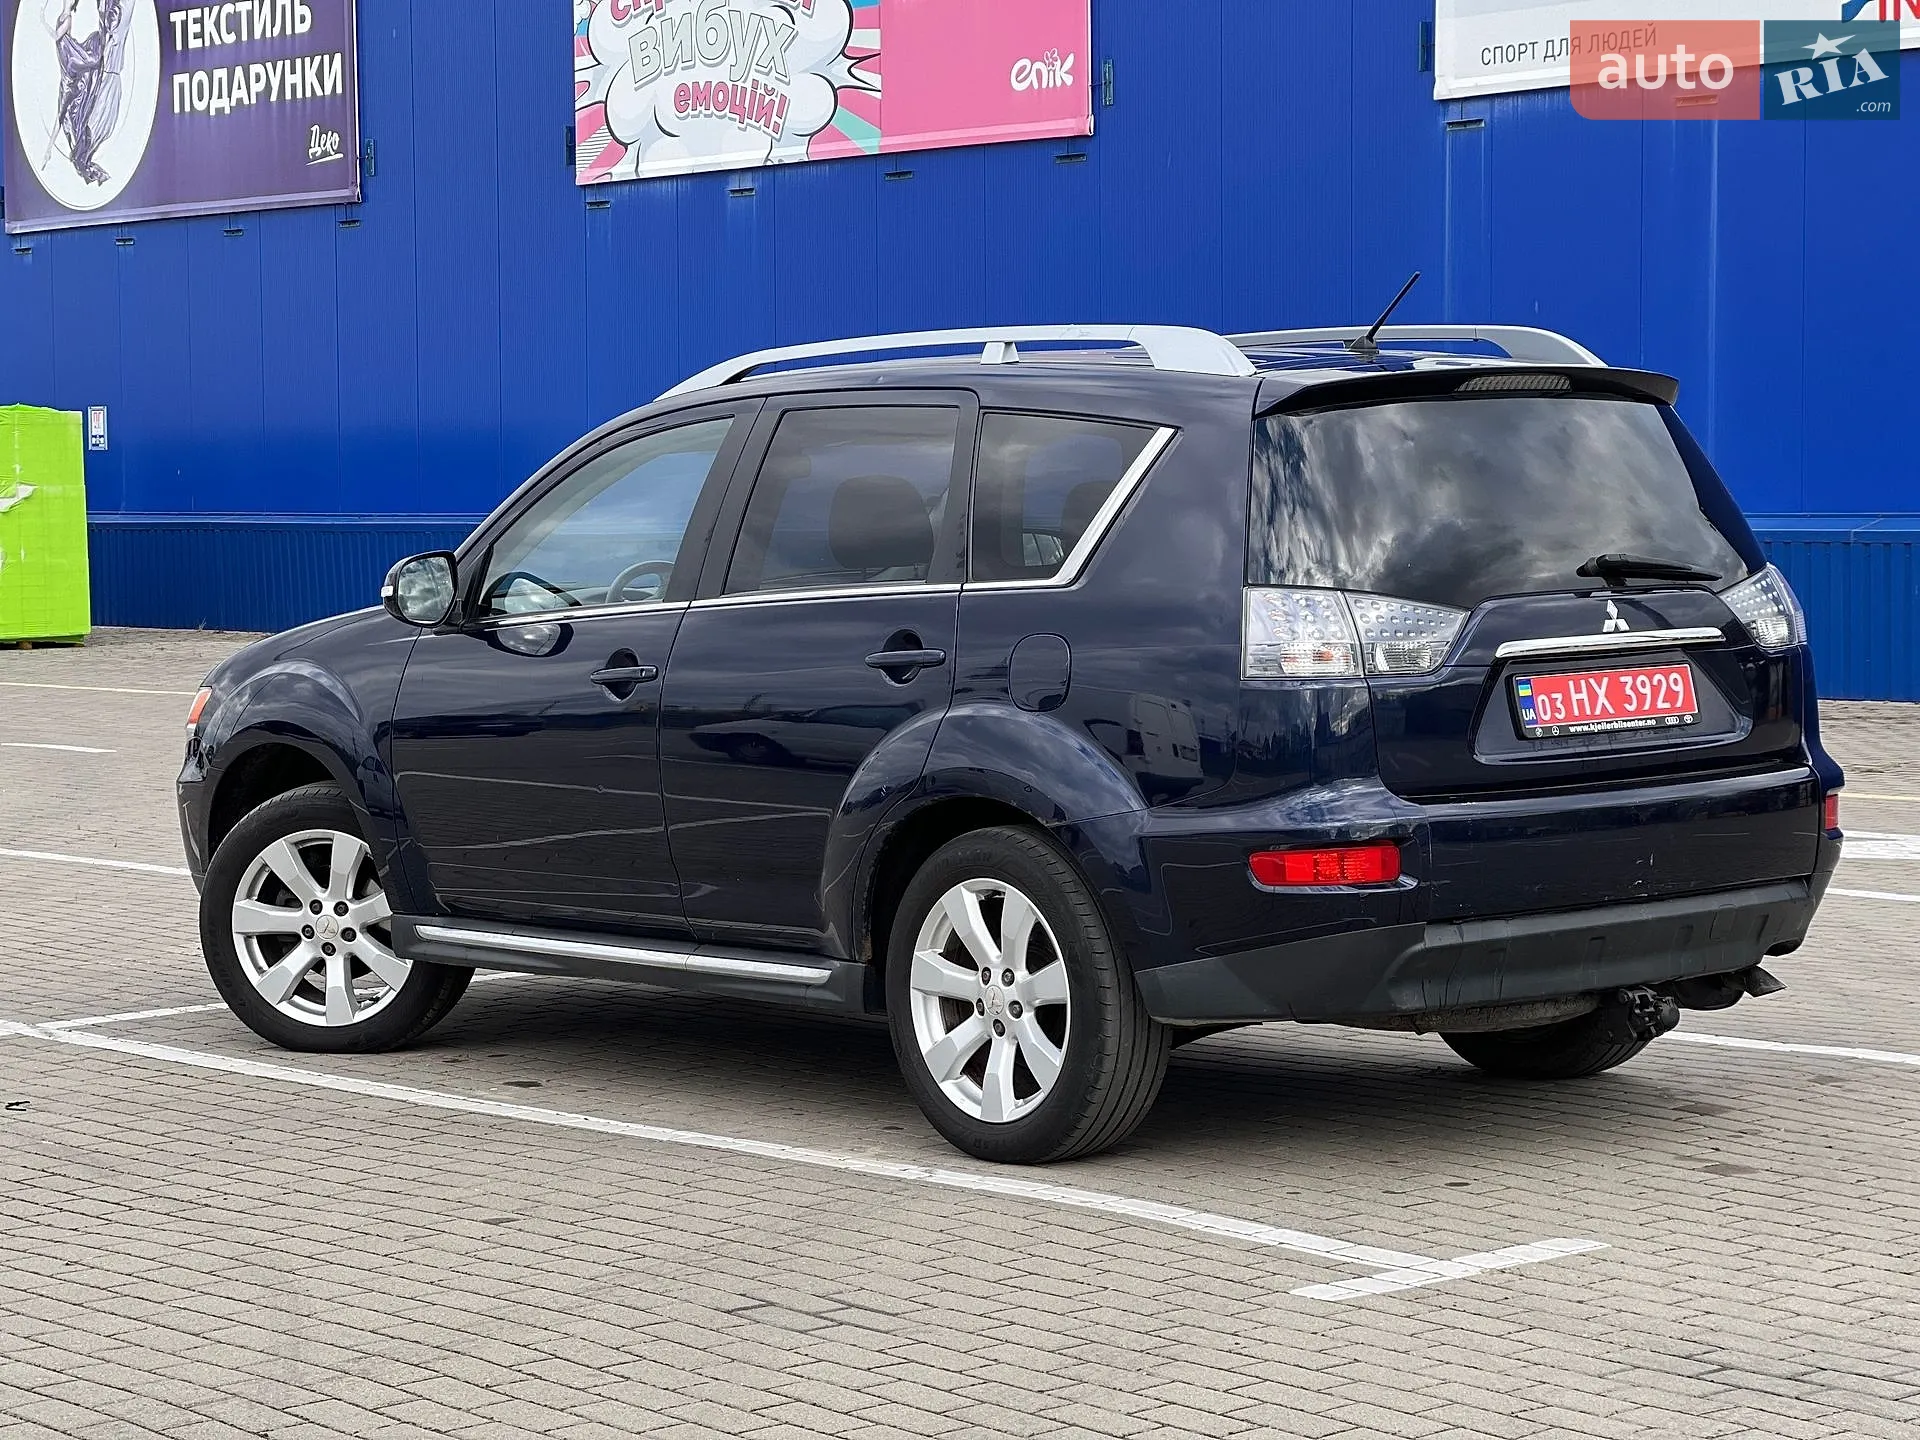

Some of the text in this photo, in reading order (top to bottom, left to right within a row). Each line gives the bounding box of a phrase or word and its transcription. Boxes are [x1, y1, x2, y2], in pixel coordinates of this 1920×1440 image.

[170, 0, 312, 51] ТЕКСТИЛЬ
[628, 0, 799, 83] вибух
[1480, 22, 1658, 66] СПОРТ ДЛЯ ЛЮДЕЙ
[171, 52, 344, 116] ПОДАРУНКИ
[673, 78, 790, 136] емоцій!
[1522, 708, 1537, 721] UA
[1536, 671, 1685, 722] 03 HX 3929
